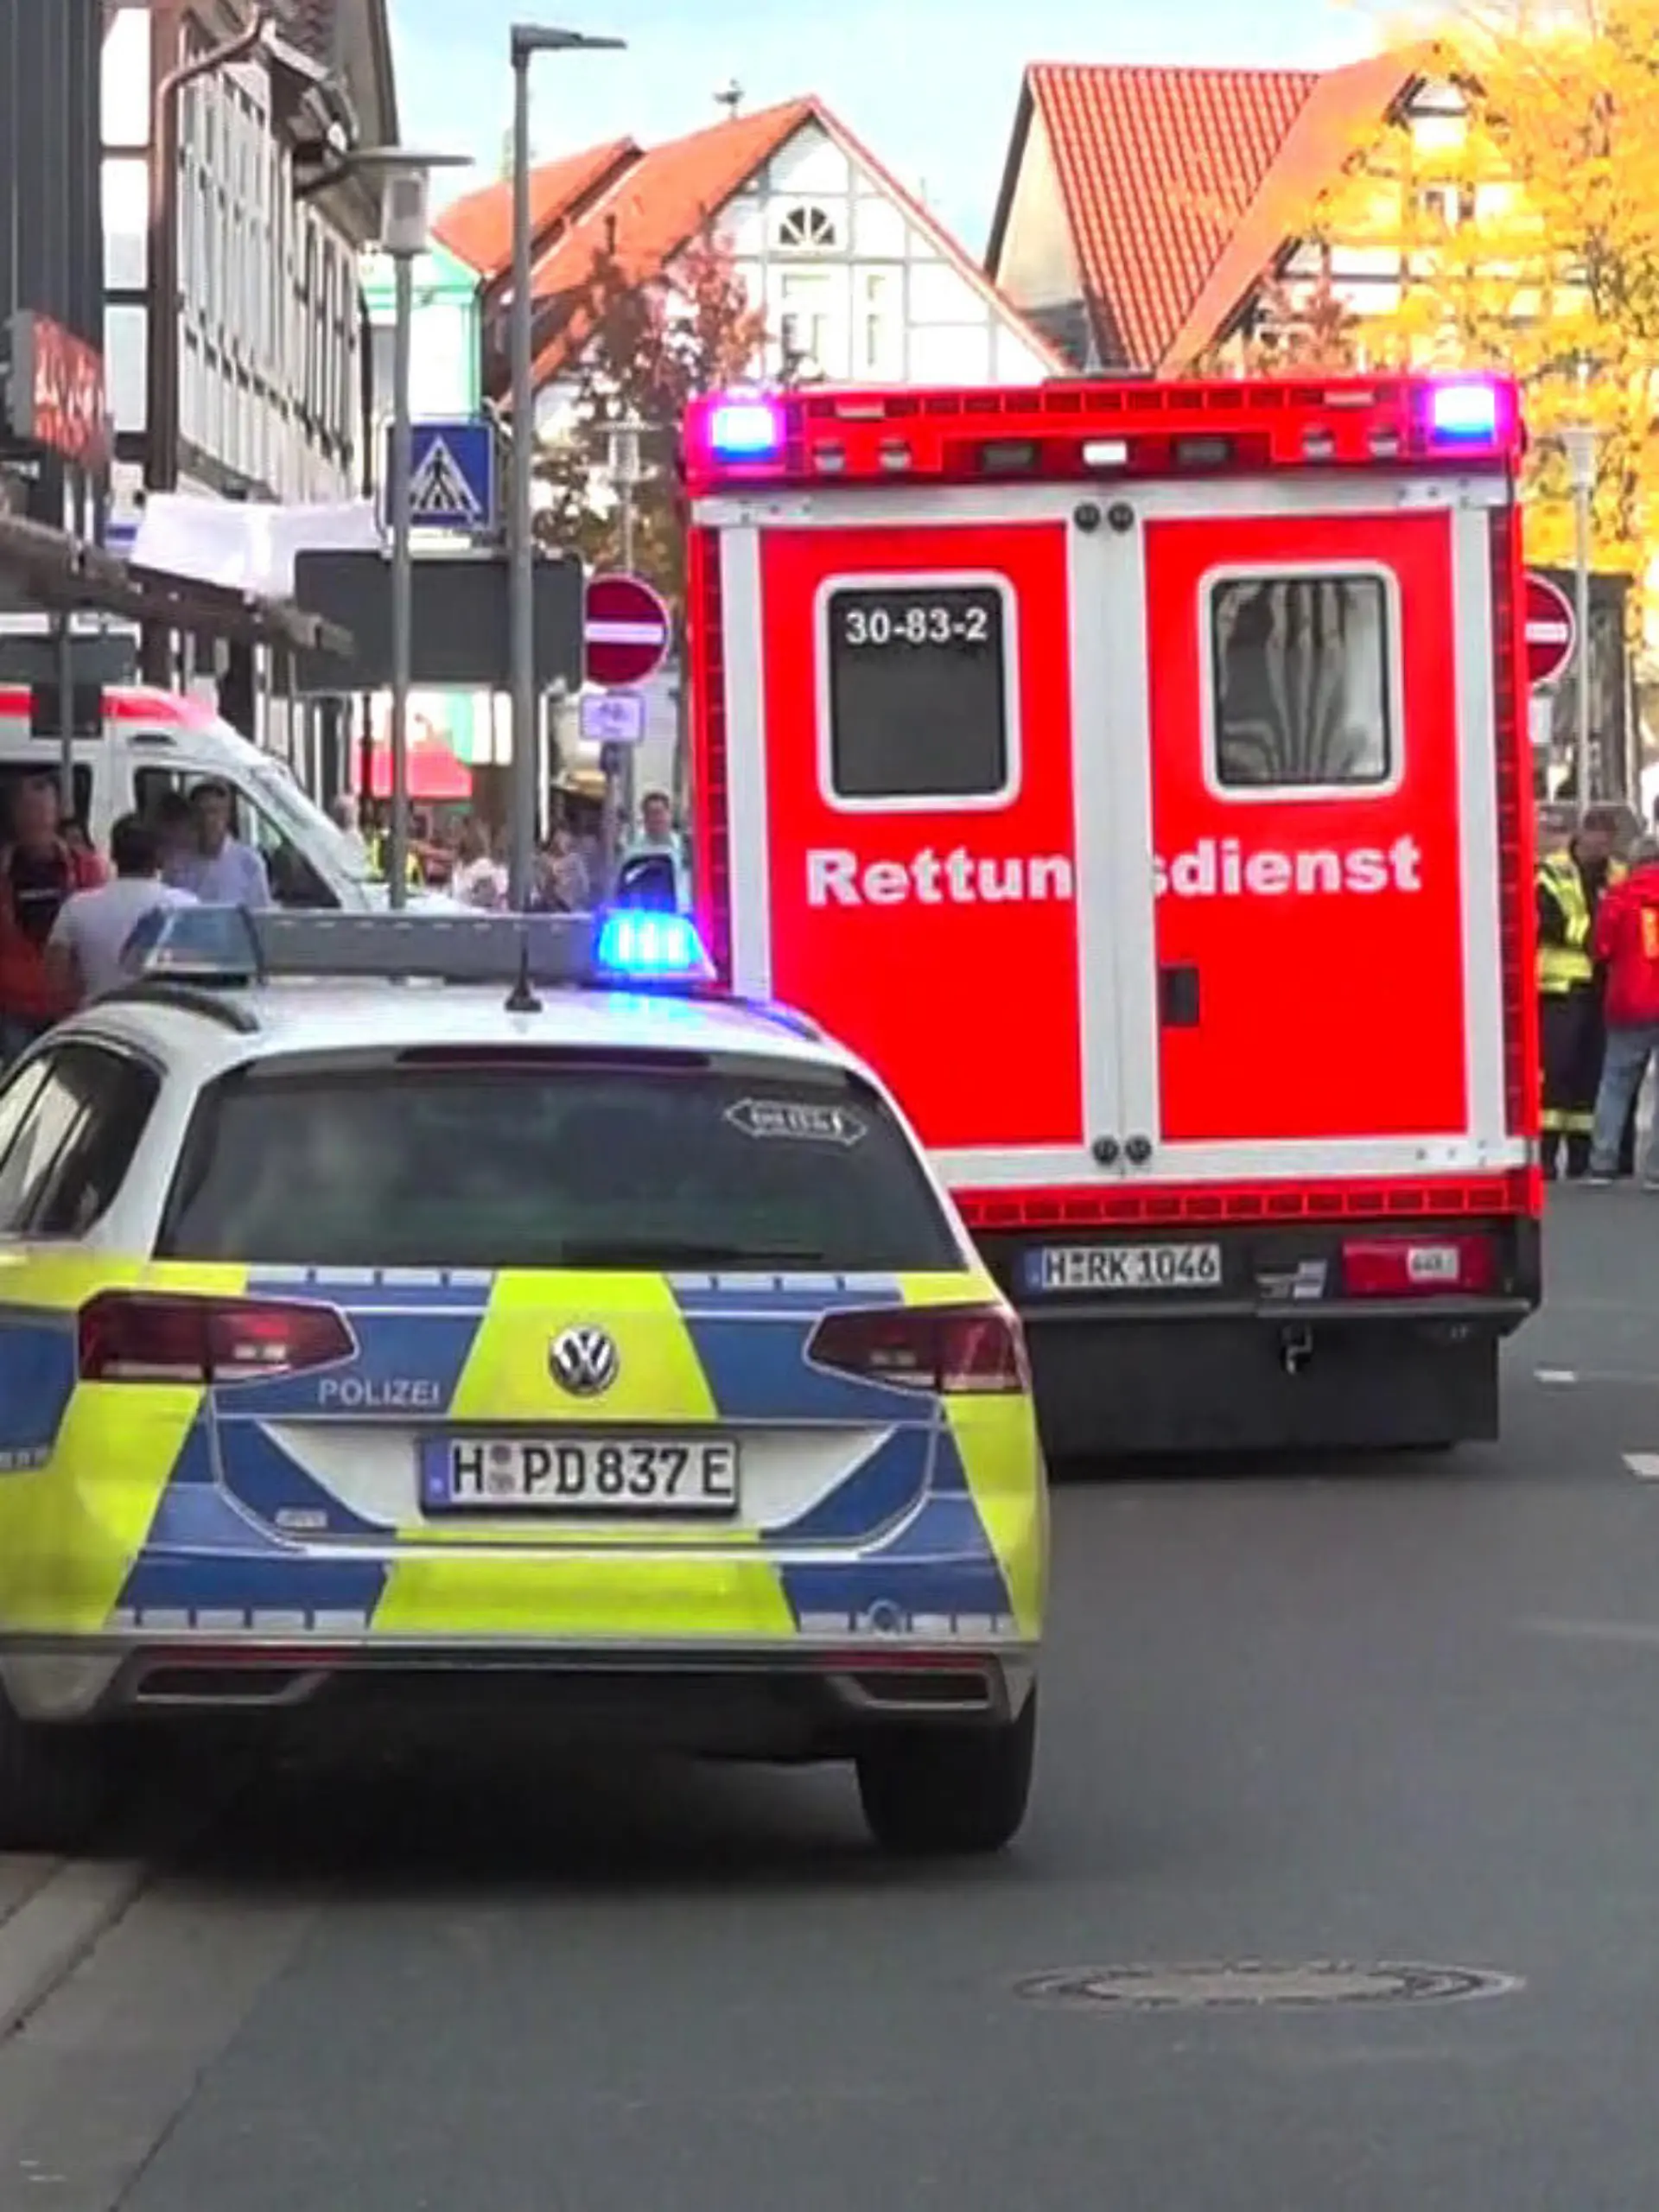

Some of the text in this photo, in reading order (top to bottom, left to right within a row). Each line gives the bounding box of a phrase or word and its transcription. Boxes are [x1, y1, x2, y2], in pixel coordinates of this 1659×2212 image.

[845, 607, 988, 645] 30-83-2
[805, 834, 1422, 909] Rettunsdienst
[1046, 1249, 1216, 1284] H RK 1046
[318, 1377, 441, 1407] POLIZEI
[454, 1446, 483, 1494] H
[521, 1446, 587, 1494] PD
